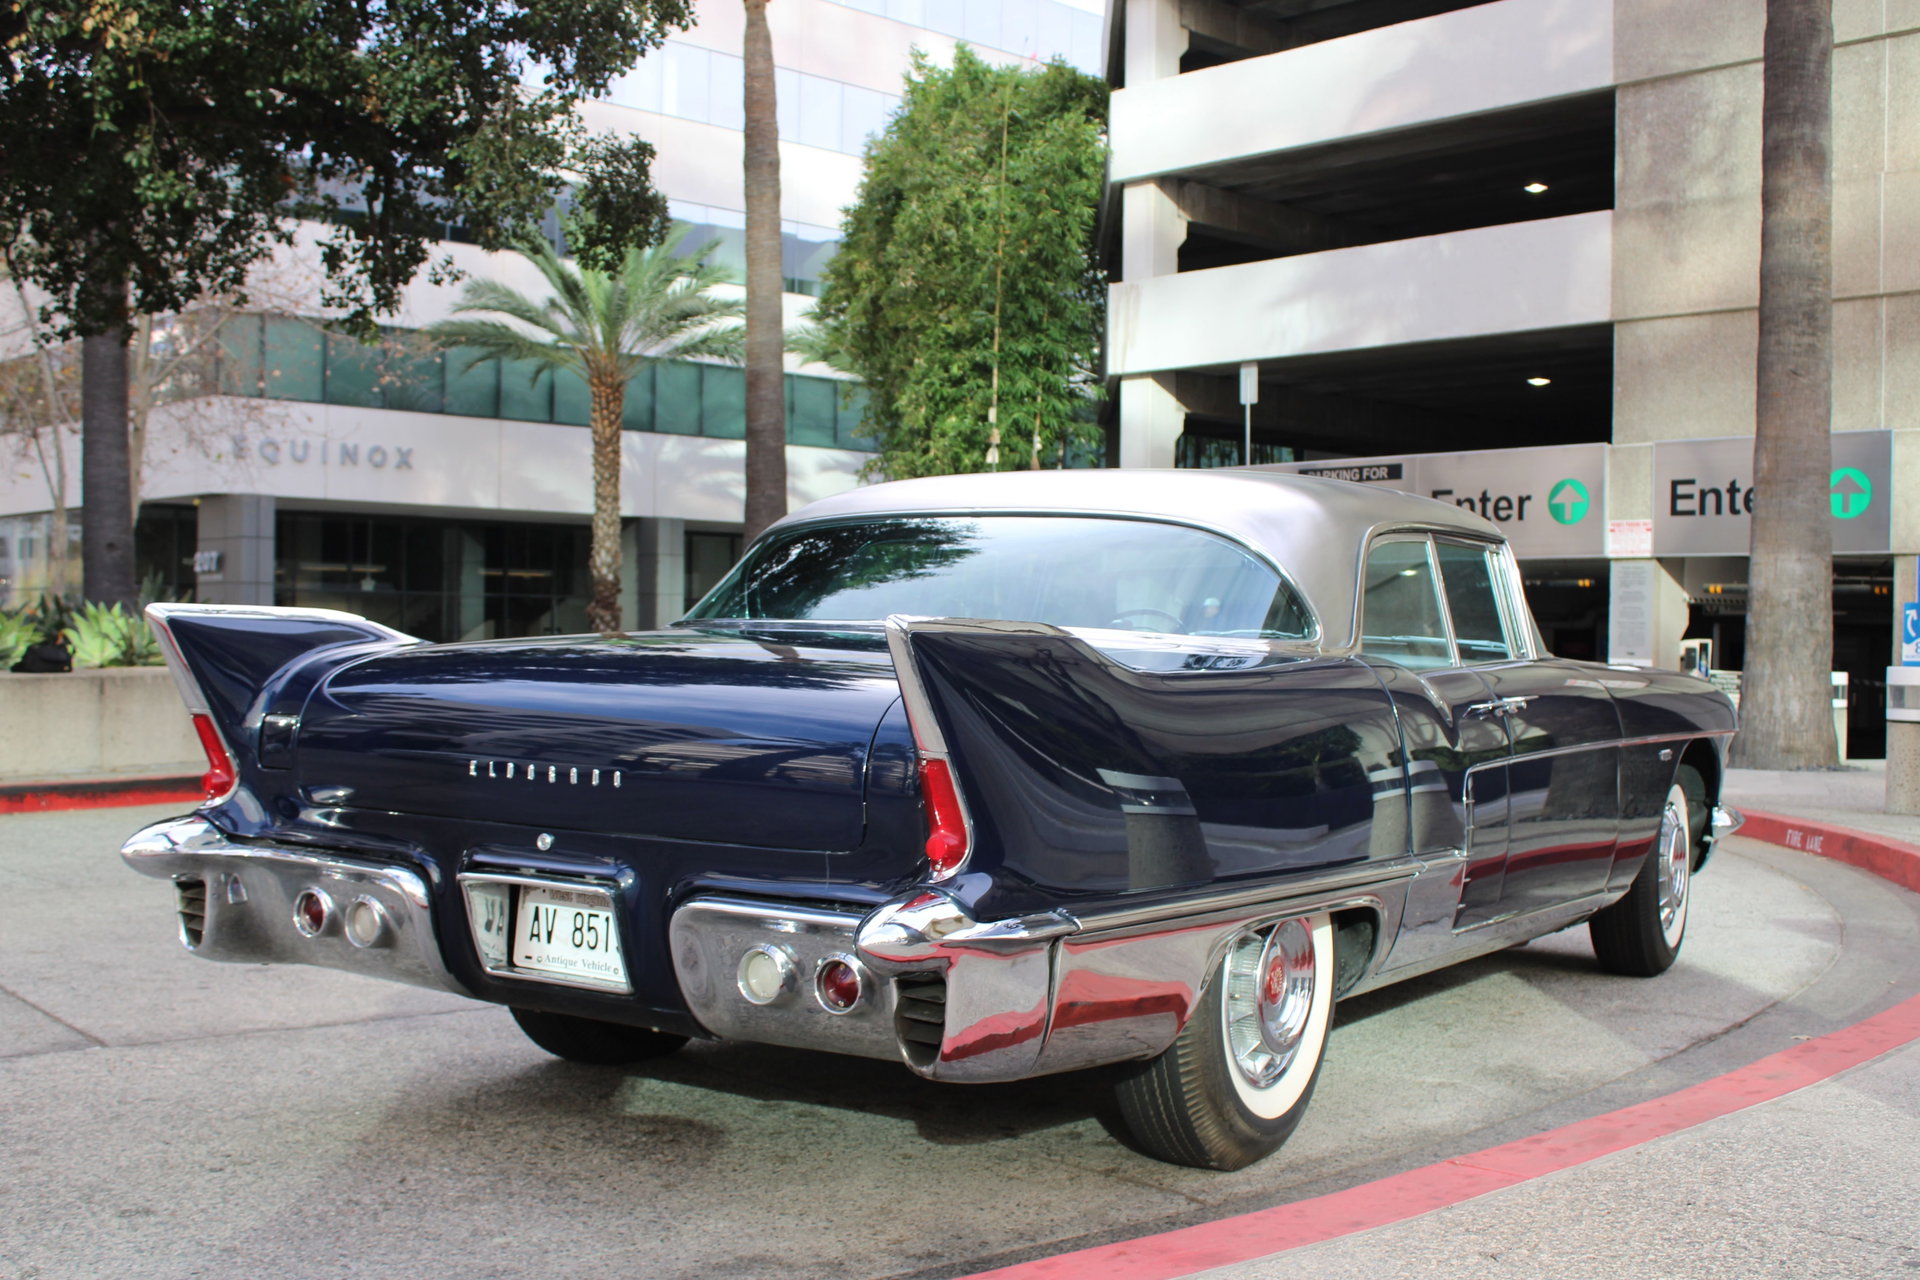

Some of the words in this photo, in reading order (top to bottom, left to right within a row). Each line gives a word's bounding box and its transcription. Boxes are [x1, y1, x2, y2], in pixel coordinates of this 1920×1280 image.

[233, 434, 414, 469] EQUINOX
[1363, 467, 1388, 479] FOR
[469, 760, 621, 788] ELDORADO
[529, 905, 557, 944] AV
[572, 911, 619, 953] 851
[545, 954, 578, 968] Antique
[582, 958, 612, 972] Vehicle
